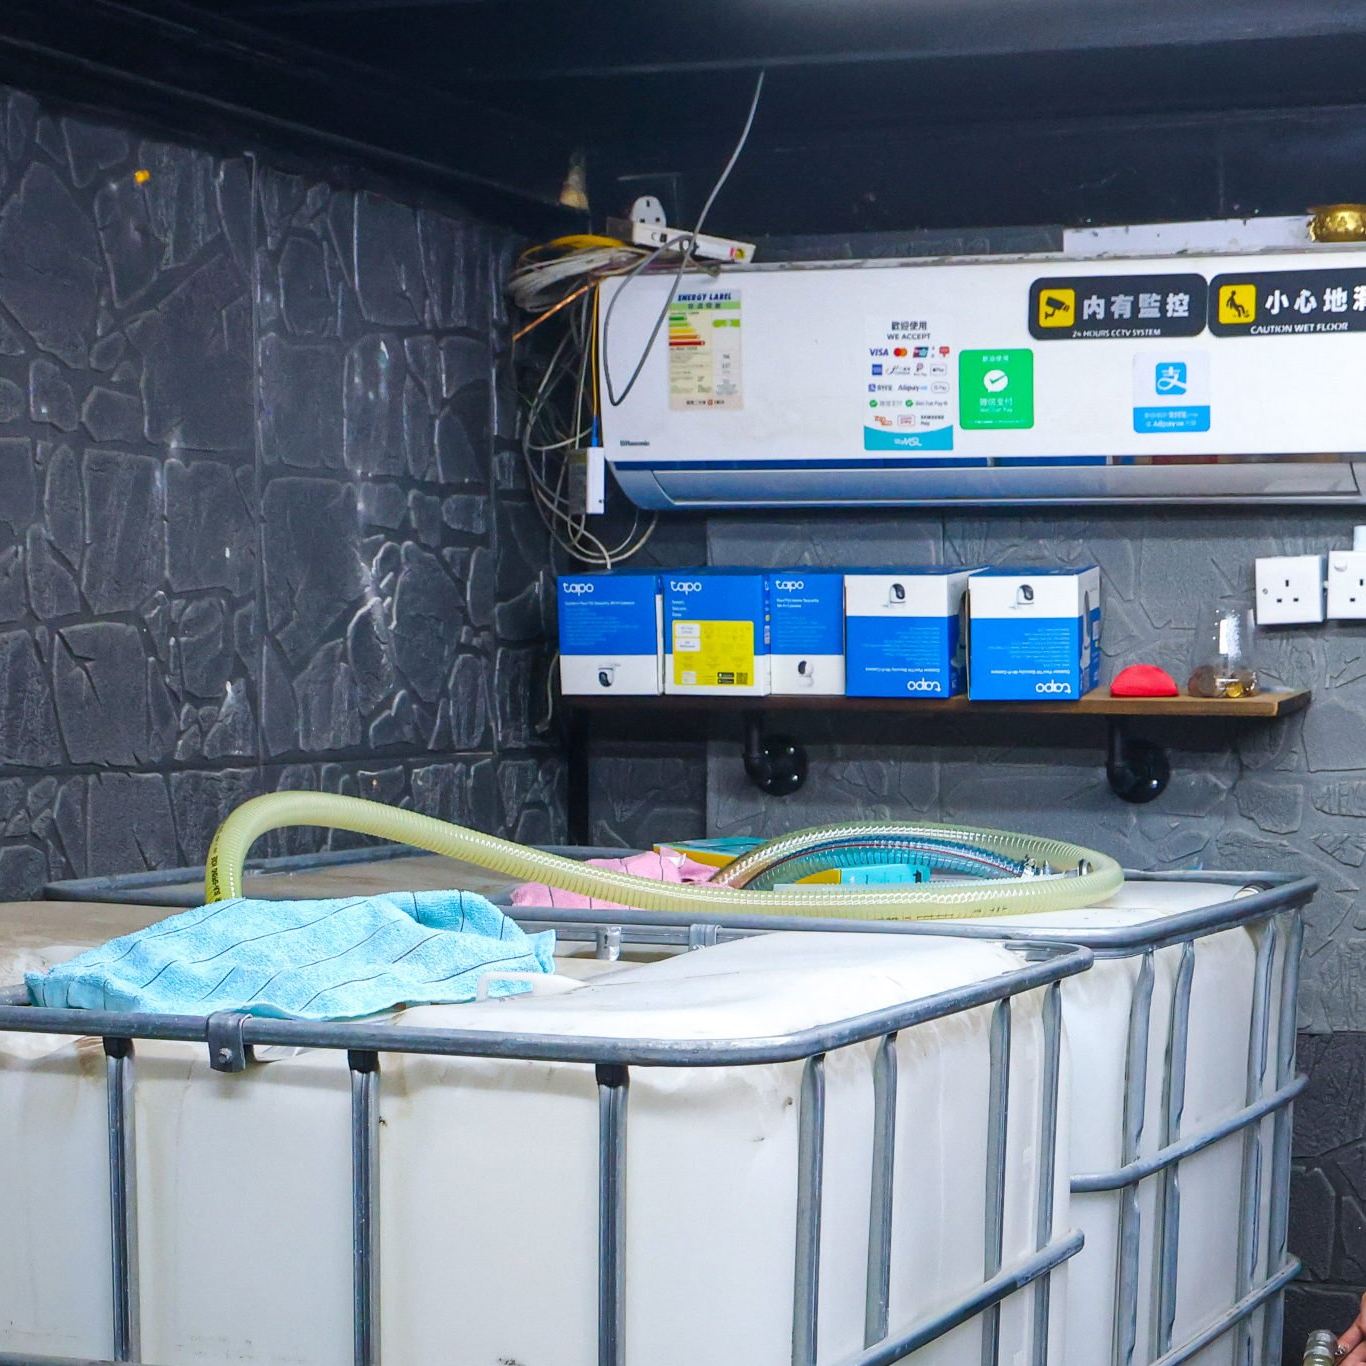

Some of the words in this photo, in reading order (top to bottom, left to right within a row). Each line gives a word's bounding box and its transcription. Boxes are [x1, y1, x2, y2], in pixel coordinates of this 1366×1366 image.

[708, 292, 732, 300] LABEL
[1250, 324, 1292, 334] CAUTION
[1294, 323, 1315, 332] WET
[1316, 322, 1348, 331] FLOOR
[869, 348, 889, 356] VISA
[563, 583, 594, 596] tapo
[670, 581, 702, 595] tapo
[775, 580, 804, 592] tapo
[907, 677, 941, 692] tapo
[1035, 679, 1071, 694] tapo
